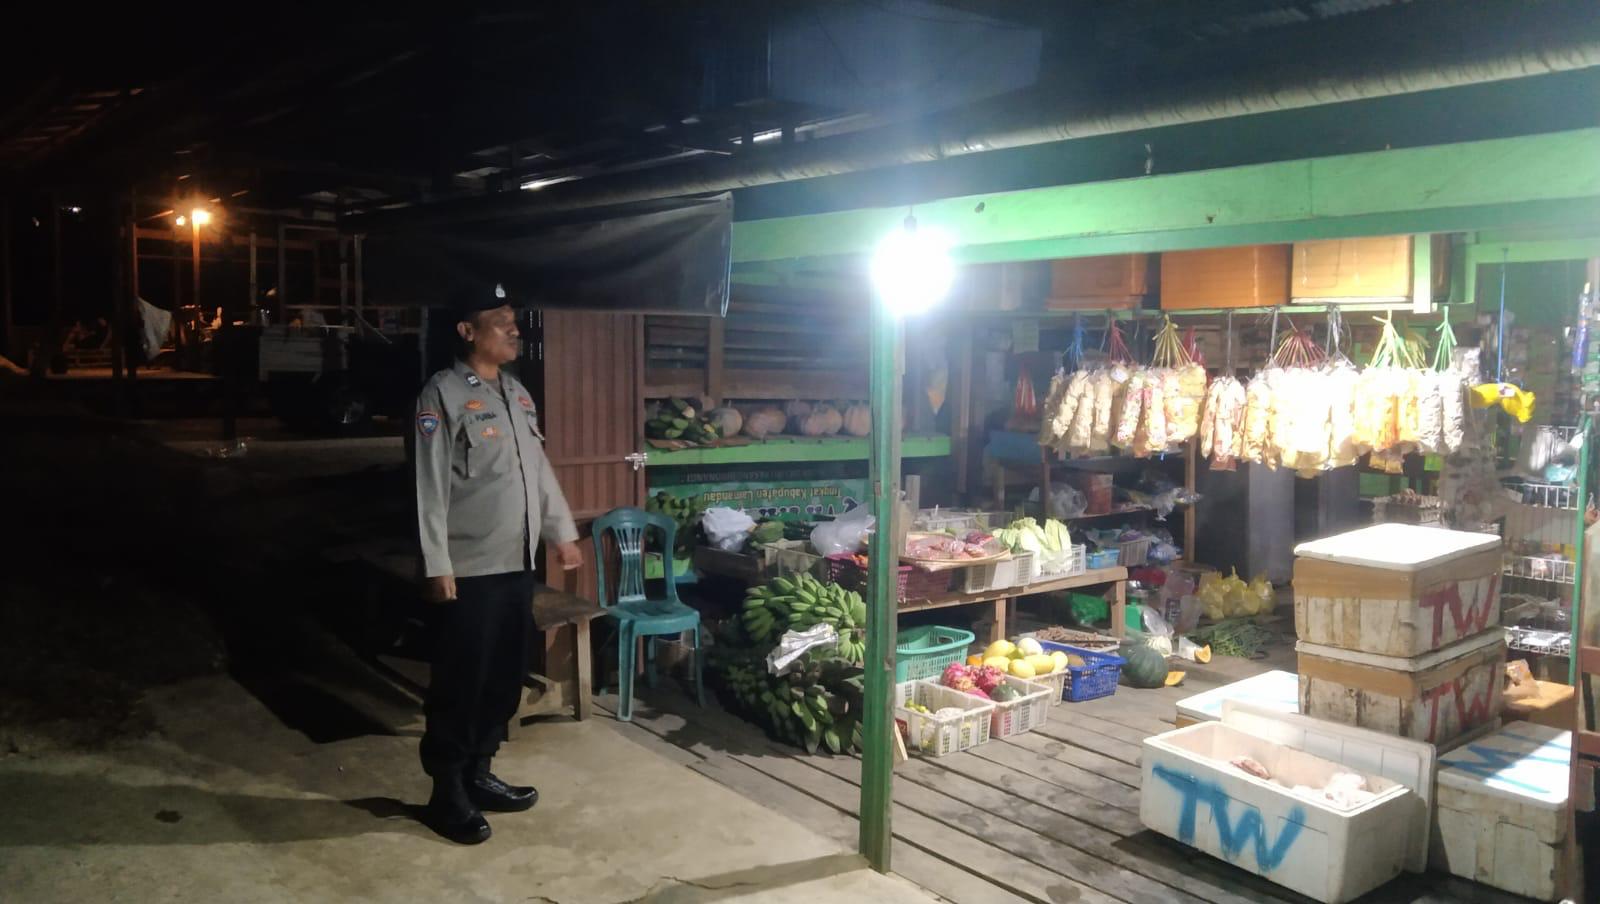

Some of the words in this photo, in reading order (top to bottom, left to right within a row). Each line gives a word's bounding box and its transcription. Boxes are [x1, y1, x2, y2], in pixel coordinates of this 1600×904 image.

[703, 490, 753, 503] Lamandau
[757, 487, 807, 500] Kabupaten
[1419, 575, 1498, 649] TW
[1421, 663, 1496, 742] TW
[1152, 763, 1305, 871] TW
